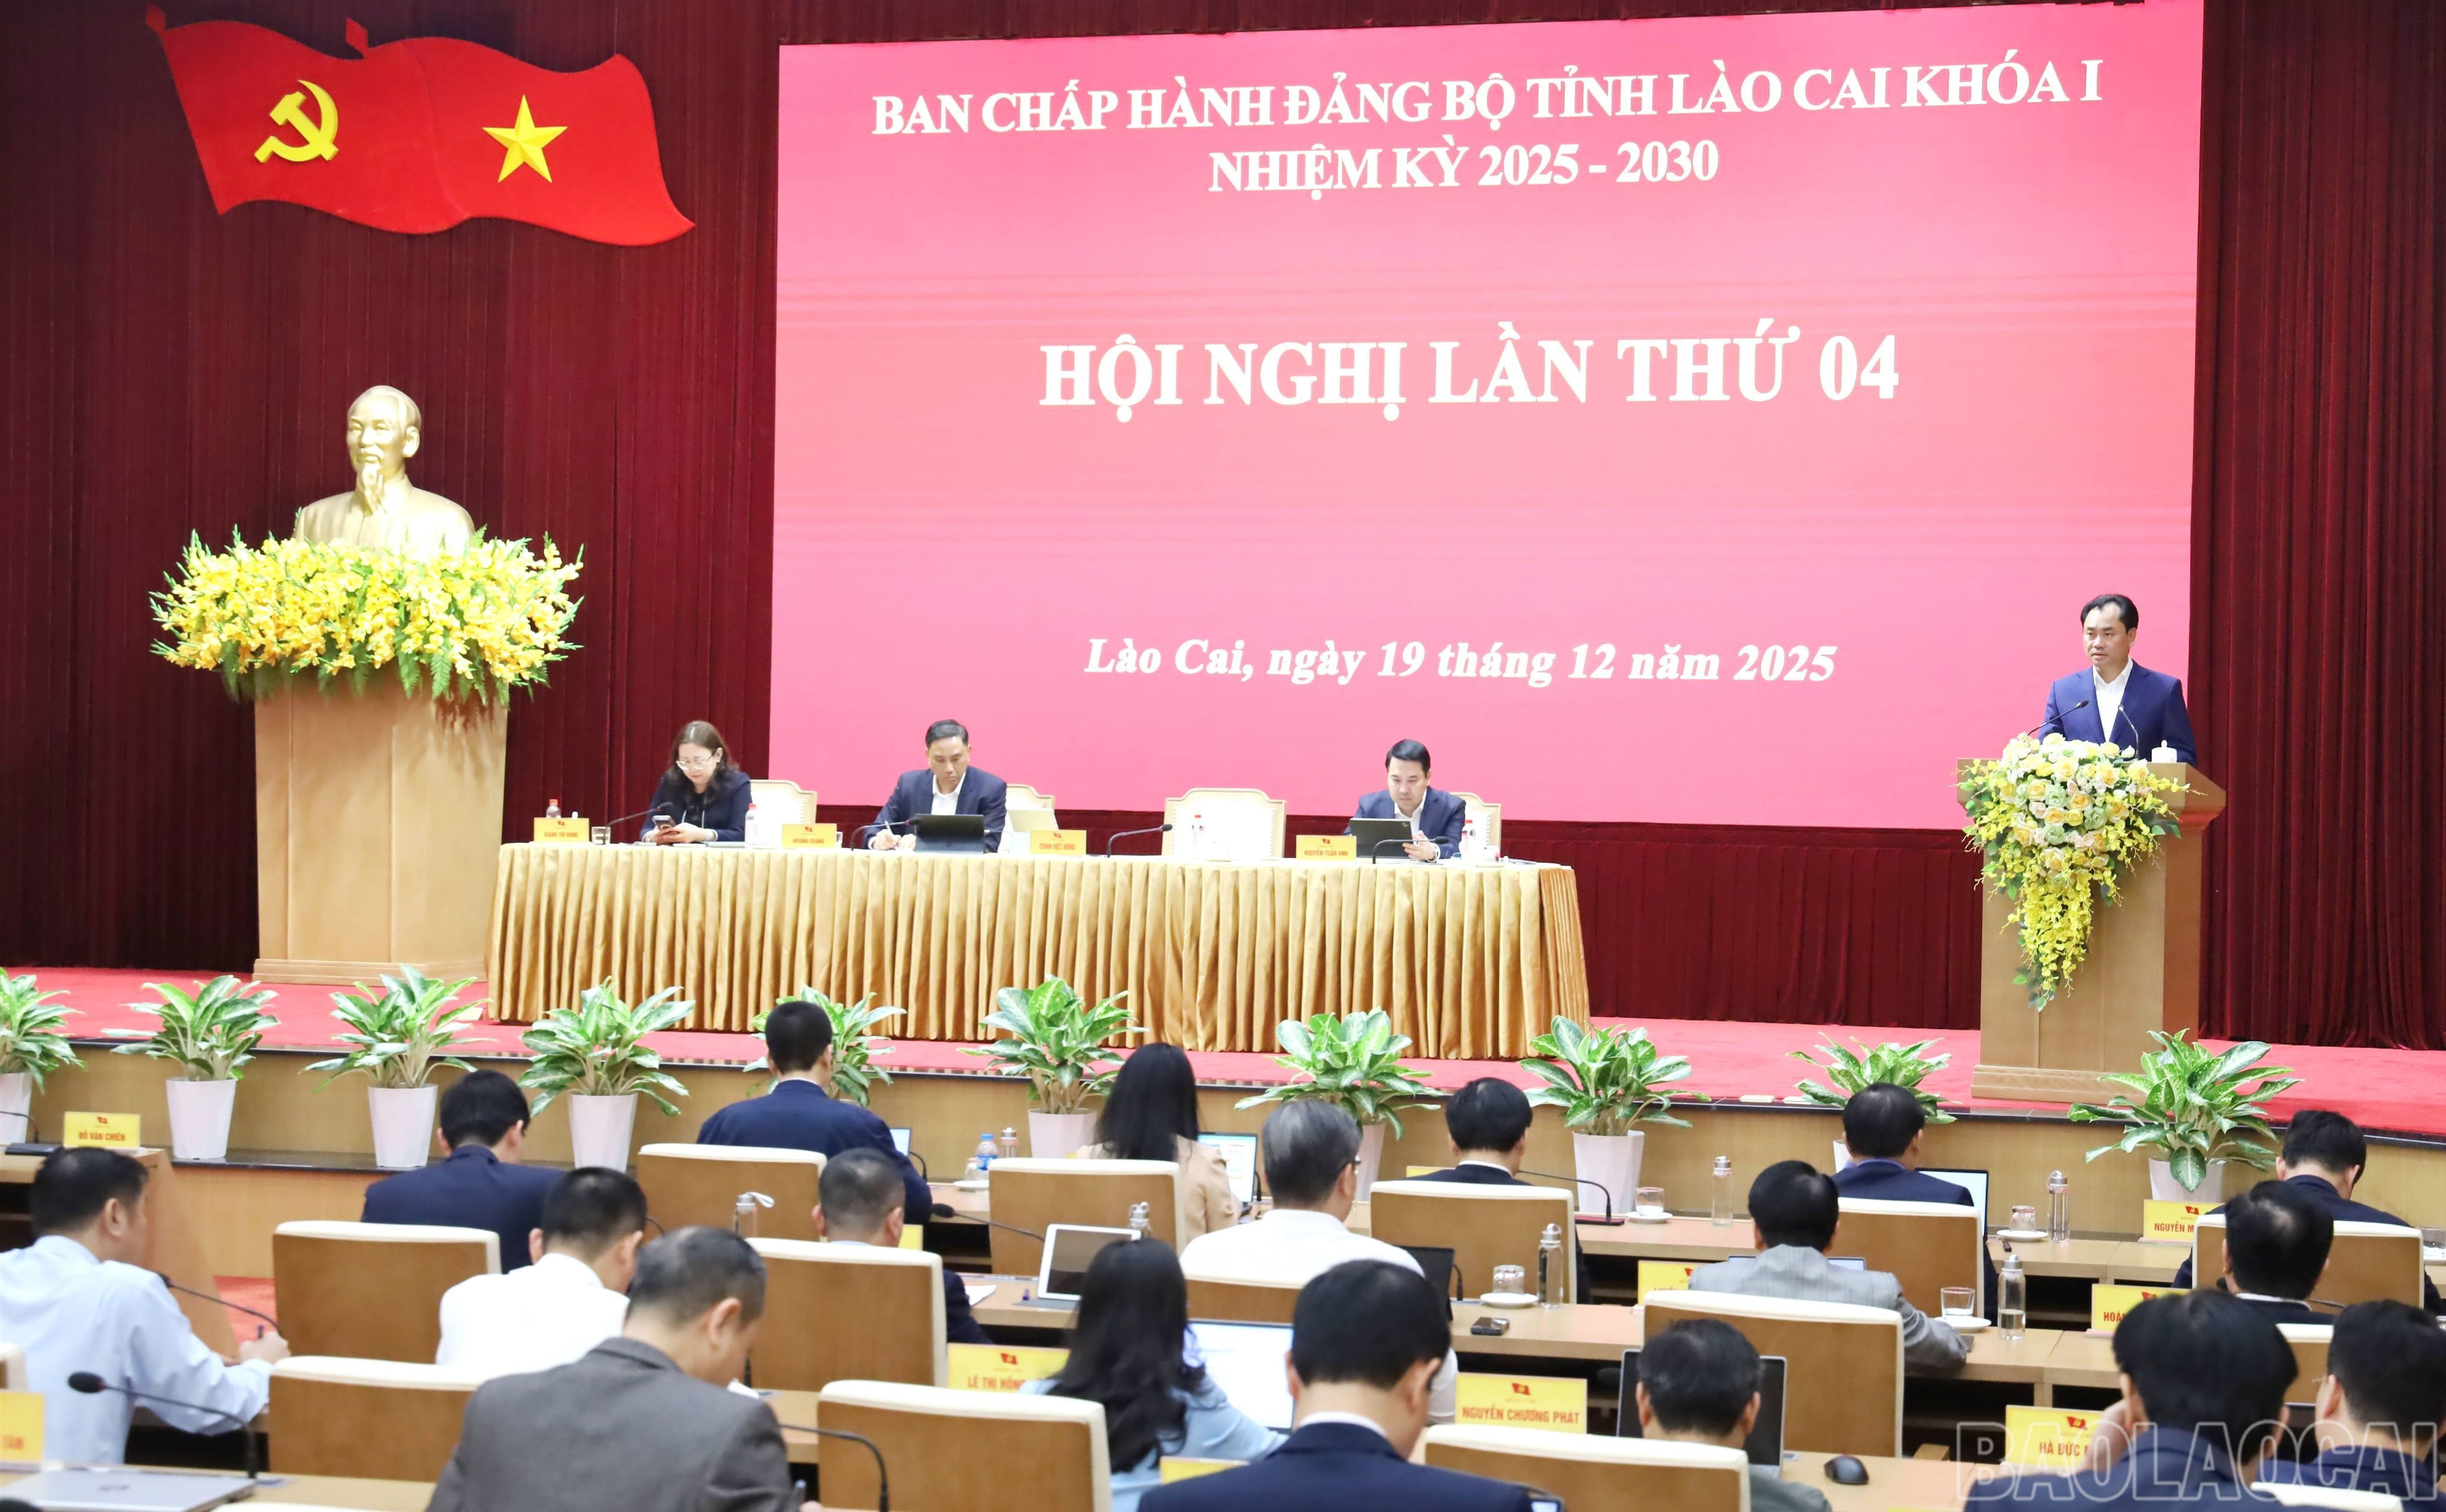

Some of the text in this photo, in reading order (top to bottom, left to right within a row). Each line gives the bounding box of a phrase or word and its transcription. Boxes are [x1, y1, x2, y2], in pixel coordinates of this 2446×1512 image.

[871, 49, 2103, 135] BAN CHẤP HÀNH ĐẢNG BỘ TỈNH LÀO CAI KHÓA I
[1208, 134, 1719, 201] NHIỆM KỲ 2025 - 2030
[1039, 317, 1899, 423] HỘI NGHỊ LẦN THỨ 04
[1084, 638, 1838, 688] Lào Cai, ngày 19 tháng 12 năm 2025
[2154, 1221, 2185, 1233] NGUYỄN
[1462, 1403, 1503, 1420] NGUYỄN
[1553, 1410, 1579, 1424] PHÁT
[2039, 1439, 2054, 1455] HÀ
